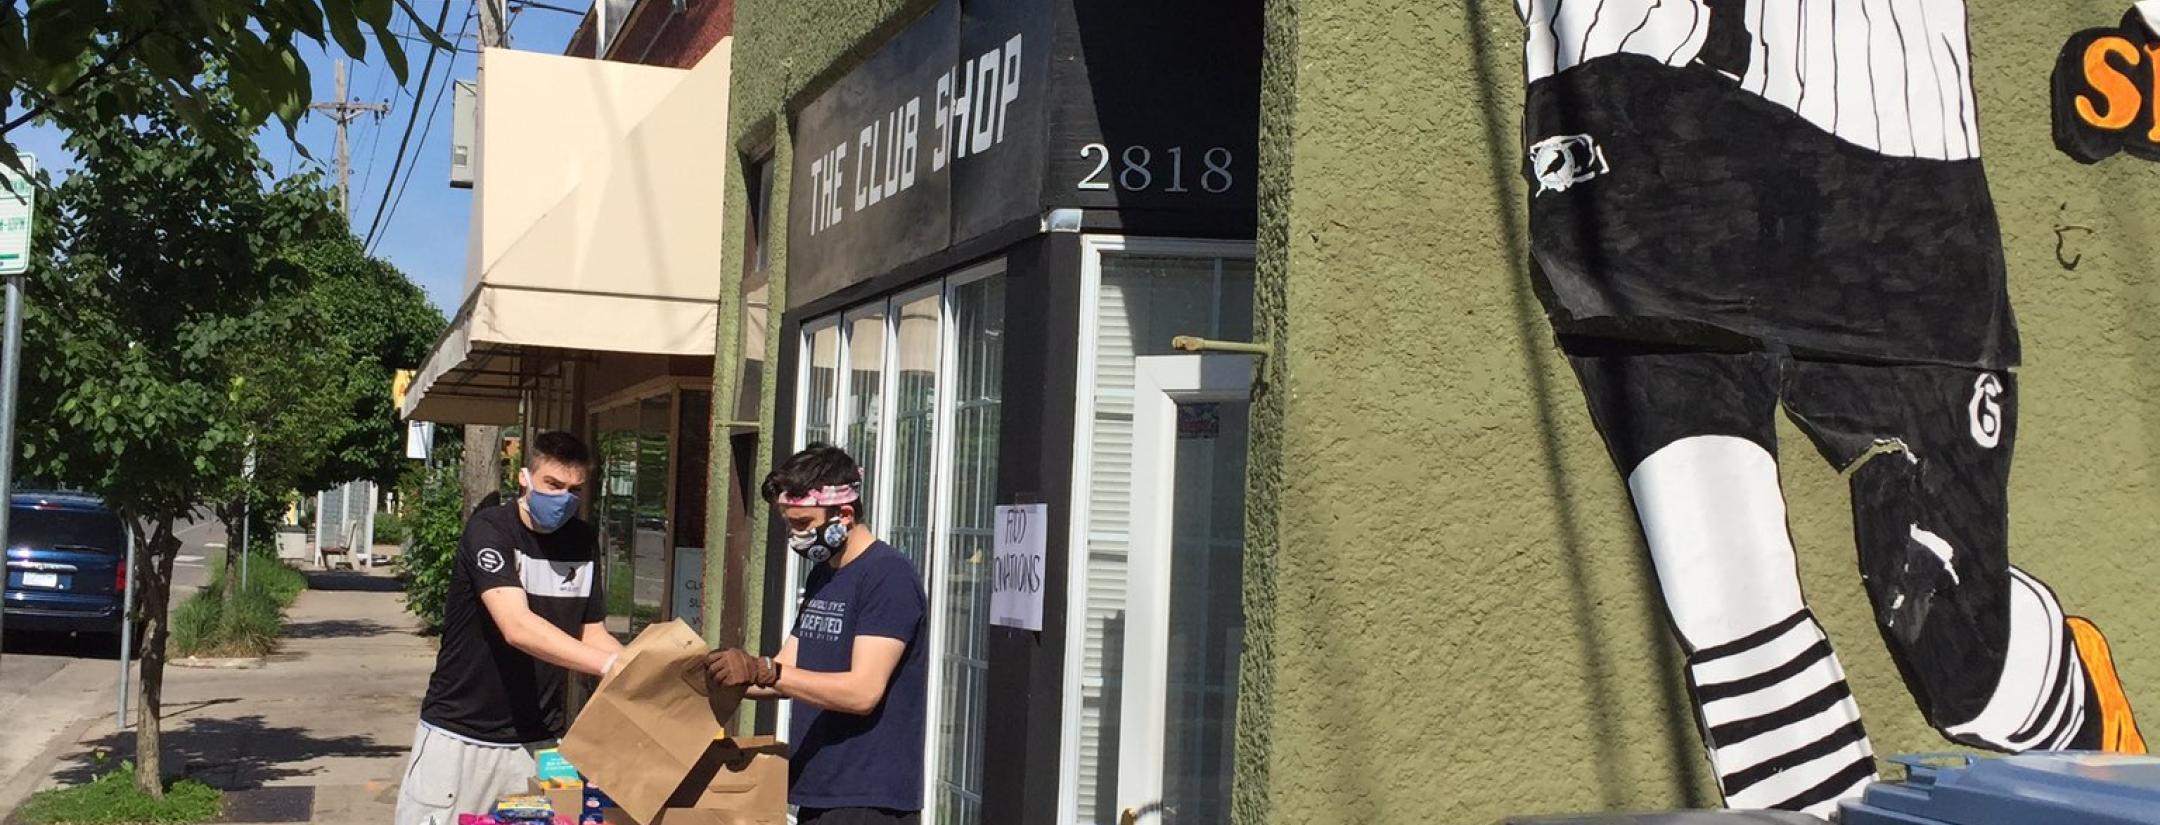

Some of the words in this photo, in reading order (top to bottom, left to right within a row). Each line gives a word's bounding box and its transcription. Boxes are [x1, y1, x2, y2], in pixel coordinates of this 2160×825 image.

[810, 141, 847, 236] THE
[855, 96, 920, 212] CLUB
[933, 33, 1022, 172] SHOP
[1077, 143, 1233, 193] 2818
[1969, 373, 2003, 448] 6
